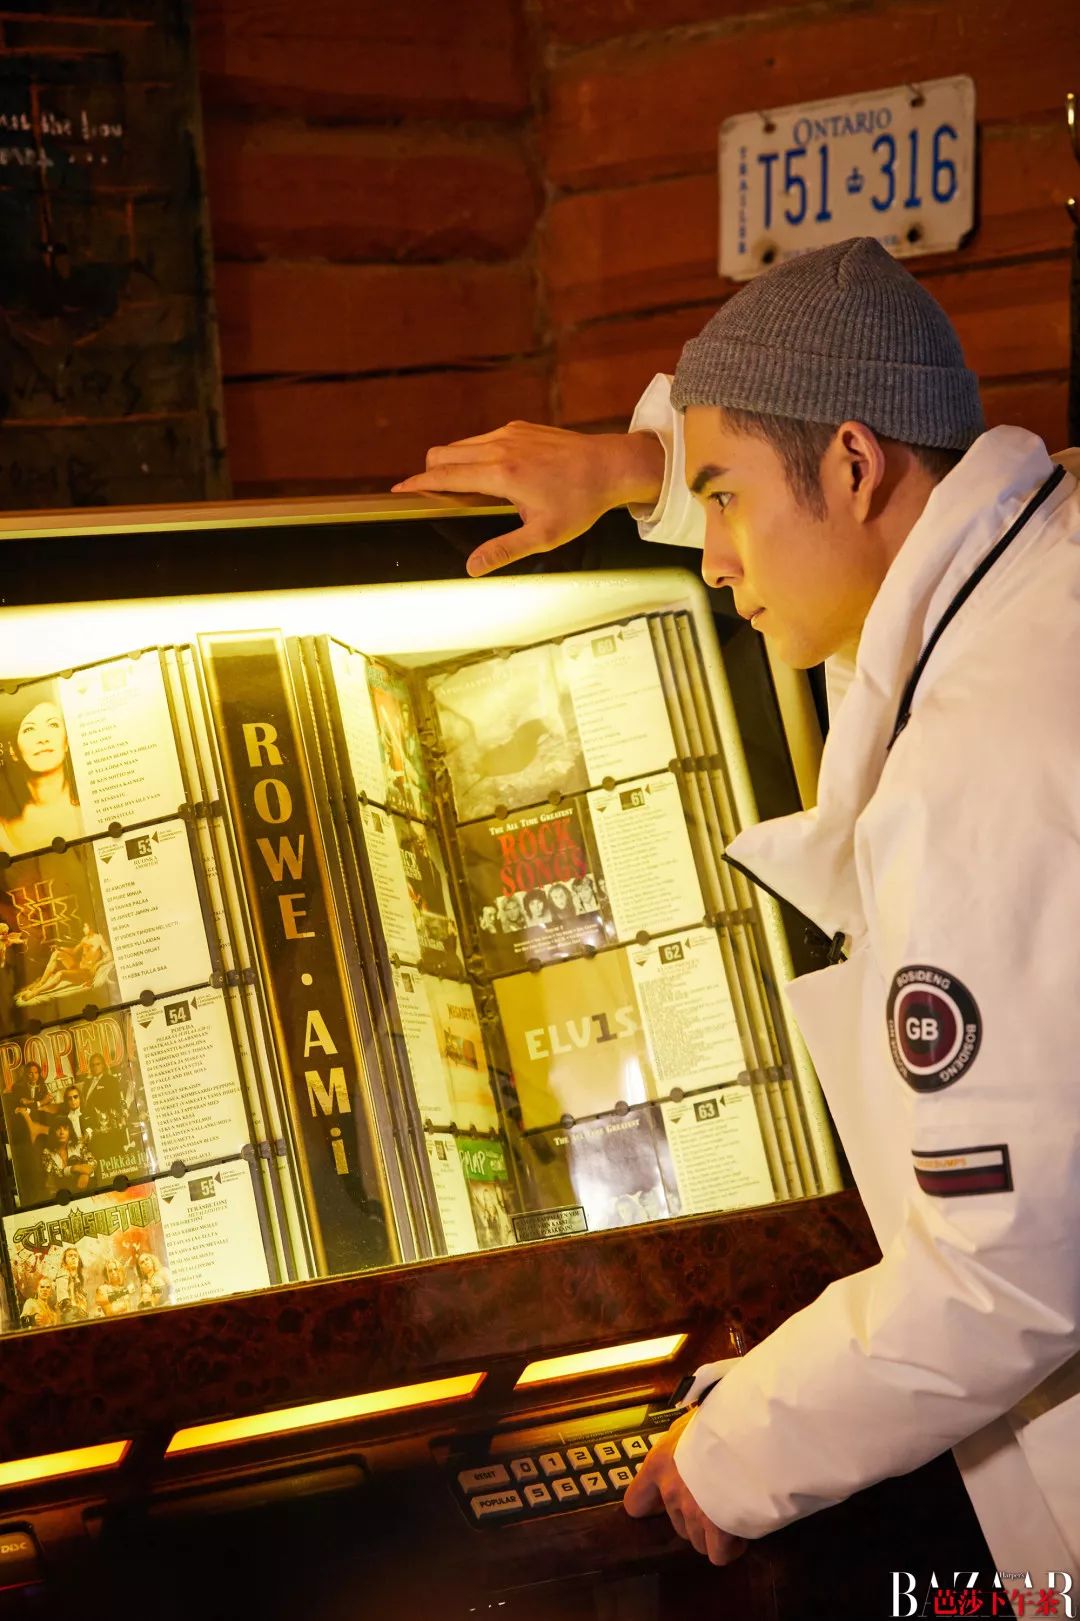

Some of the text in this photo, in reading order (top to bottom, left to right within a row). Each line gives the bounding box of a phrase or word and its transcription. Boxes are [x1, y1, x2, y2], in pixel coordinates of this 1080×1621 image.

[793, 108, 892, 145] ONTARIO
[758, 124, 958, 230] T51 316
[241, 721, 316, 941] ROWE
[497, 819, 576, 866] ROCK
[498, 846, 587, 898] SONGS
[664, 944, 682, 962] 62
[896, 970, 951, 991] BOSIDENG
[169, 1007, 187, 1024] 54
[905, 1016, 939, 1041] GB
[938, 1023, 977, 1082] BOSIDENG
[697, 1102, 715, 1118] 63
[547, 1457, 556, 1467] 1
[574, 1451, 587, 1462] 2
[604, 1446, 615, 1456] 3
[631, 1440, 642, 1450] 4
[479, 1471, 629, 1509] POPULAR 5 6 7 8
